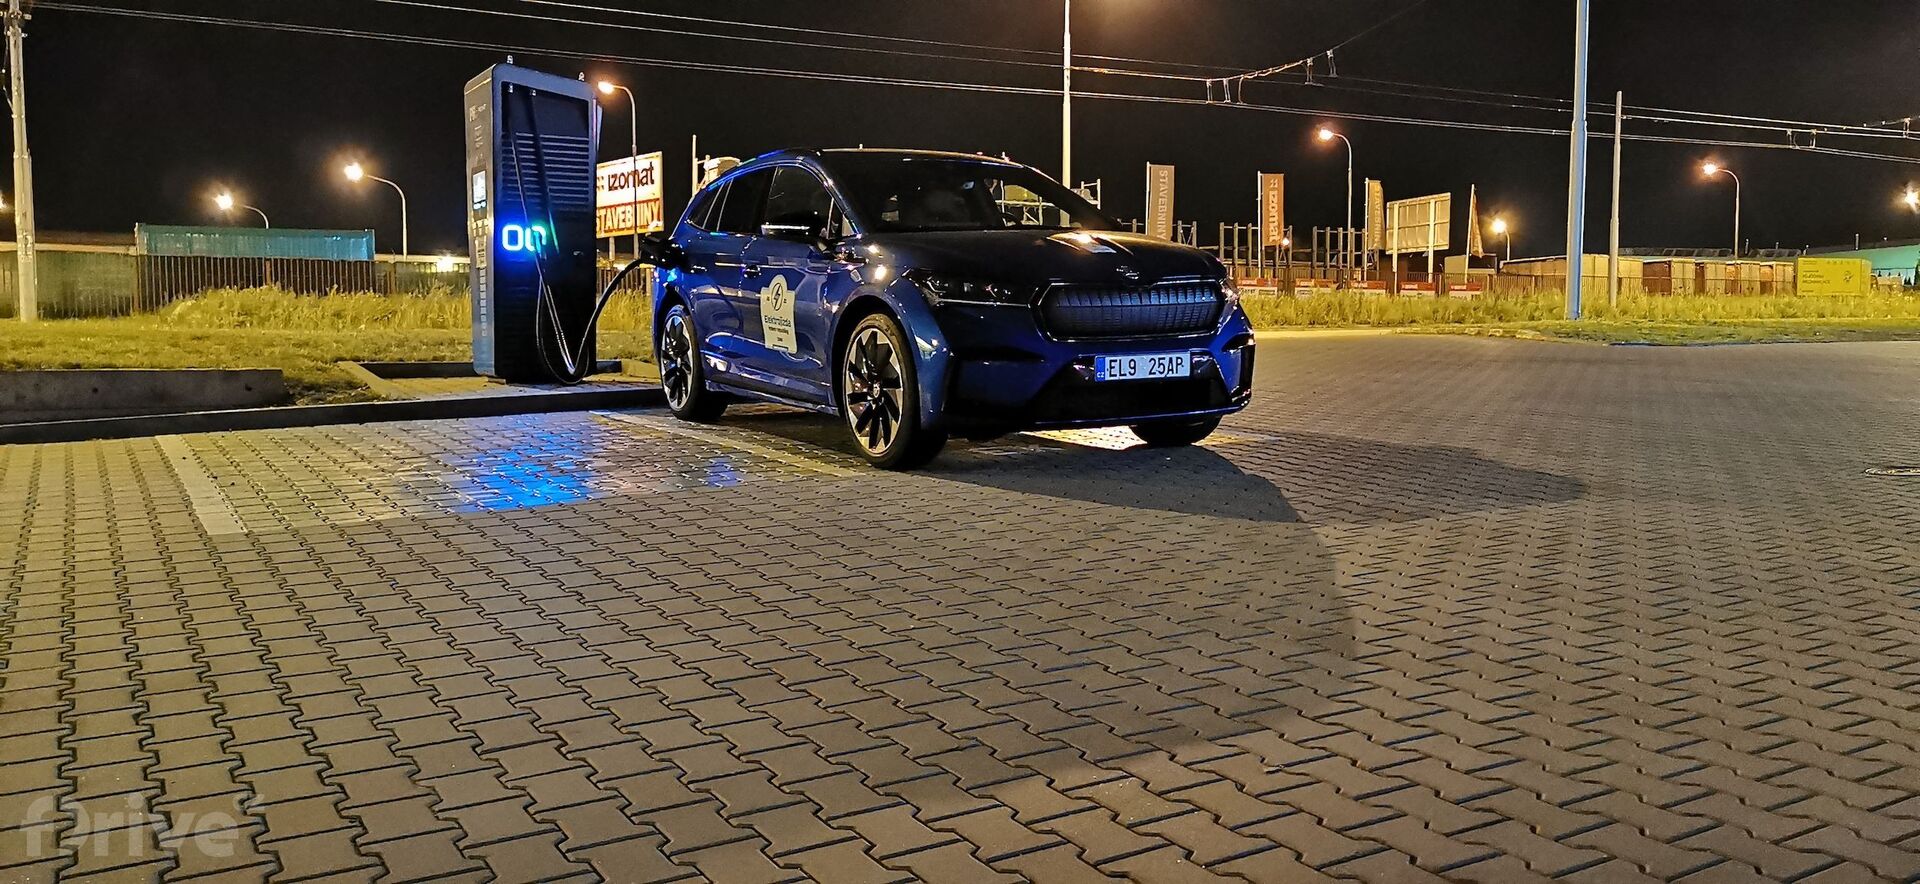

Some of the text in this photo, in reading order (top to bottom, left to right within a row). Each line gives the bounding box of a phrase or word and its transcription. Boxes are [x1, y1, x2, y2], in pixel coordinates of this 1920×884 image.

[608, 161, 655, 191] izomat
[1156, 170, 1168, 240] STAVEBNINY
[1268, 190, 1280, 242] izomat
[1108, 356, 1184, 378] EL9 25AP
